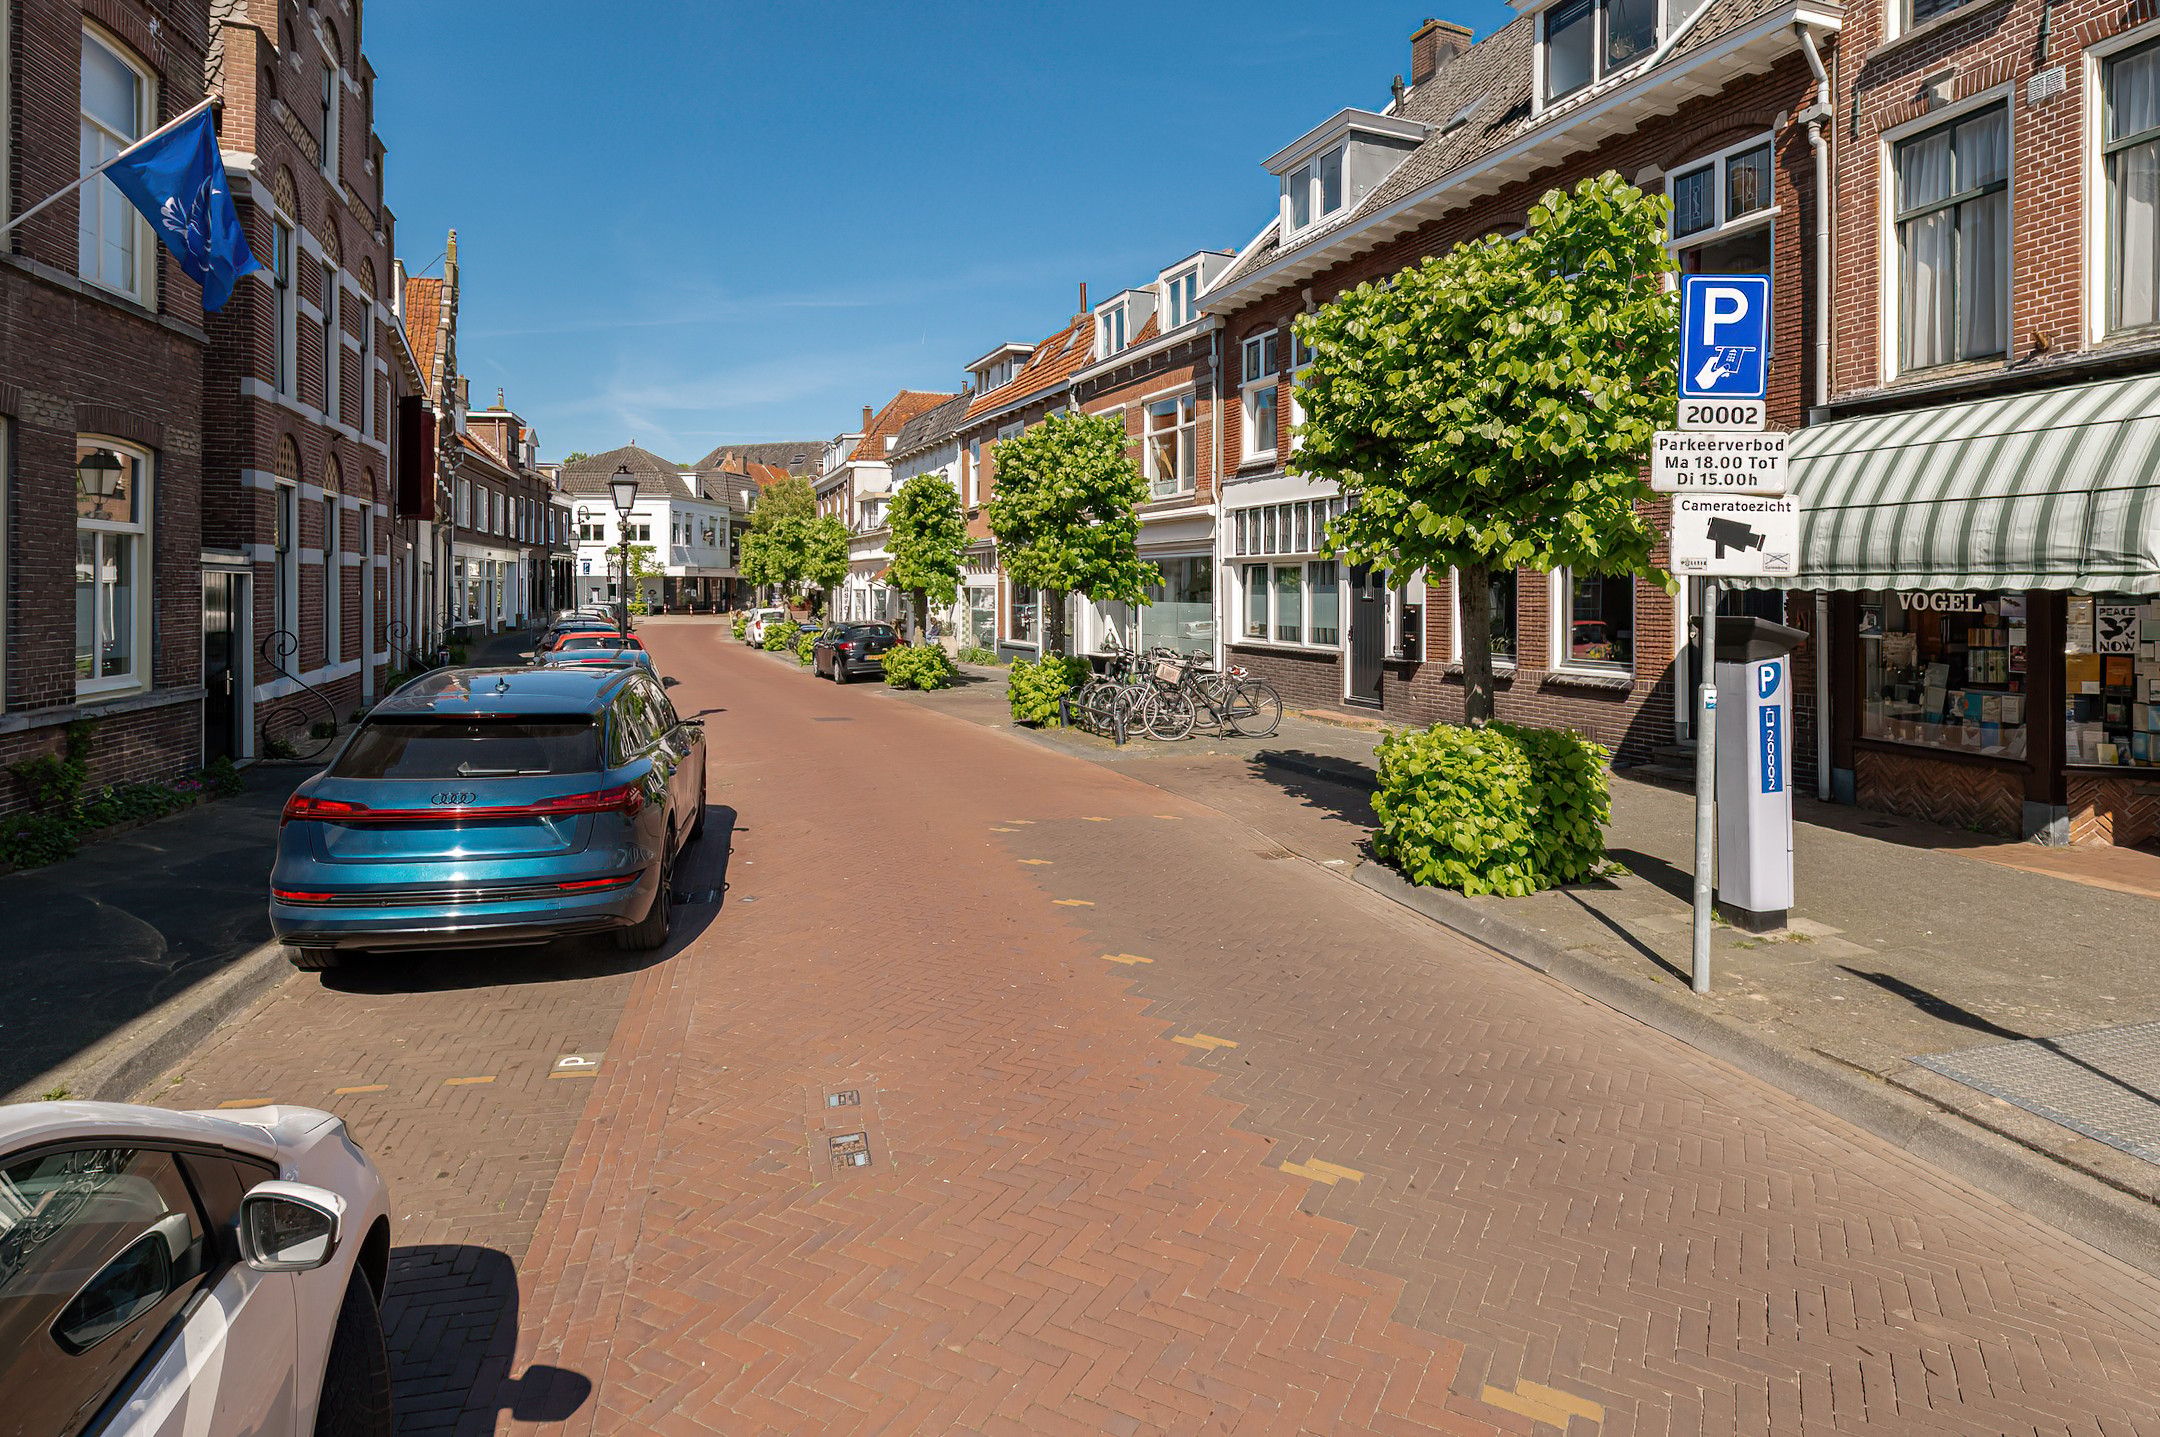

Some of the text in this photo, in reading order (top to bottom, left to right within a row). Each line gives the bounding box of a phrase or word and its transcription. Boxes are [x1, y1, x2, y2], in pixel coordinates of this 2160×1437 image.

[1703, 287, 1749, 345] P
[1686, 406, 1758, 424] 20002
[1659, 438, 1784, 451] Parkeerverbod
[1665, 456, 1778, 469] Ma 18.00 ToT
[1677, 472, 1758, 486] Di 15.00h
[1681, 500, 1792, 512] Cameratoezicht
[1897, 592, 1983, 613] VOGEL
[2099, 607, 2136, 616] PEACE
[2099, 641, 2136, 652] NOW
[1760, 666, 1775, 692] P
[1766, 729, 1776, 791] 20002
